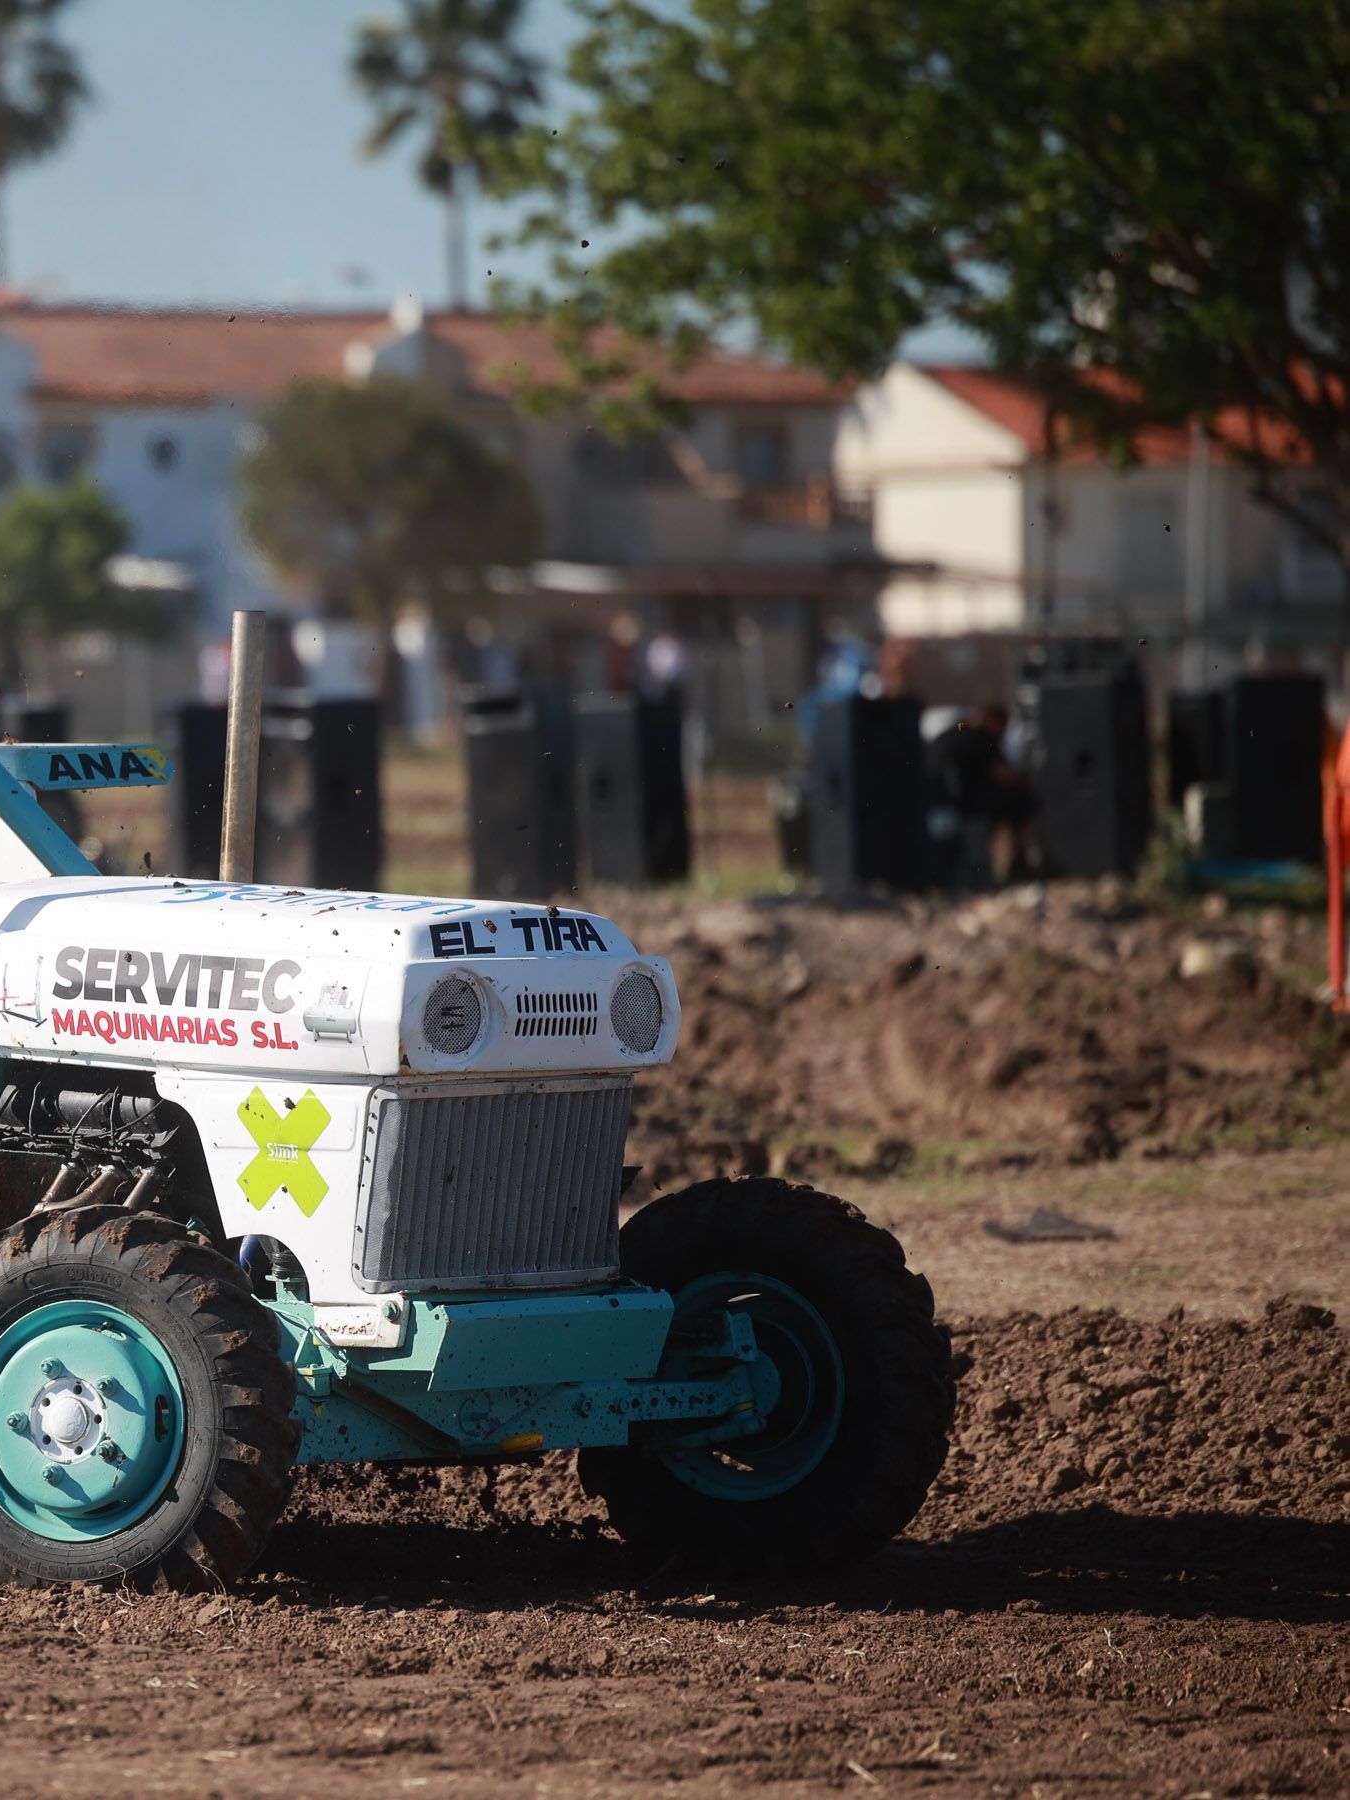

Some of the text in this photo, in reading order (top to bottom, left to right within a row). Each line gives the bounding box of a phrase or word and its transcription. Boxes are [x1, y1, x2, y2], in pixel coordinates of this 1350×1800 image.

[49, 752, 153, 781] ANA
[429, 917, 608, 957] EL TIRA
[52, 946, 302, 1014] SERVITEC
[52, 1008, 298, 1050] MAQUINARIAS S.L.
